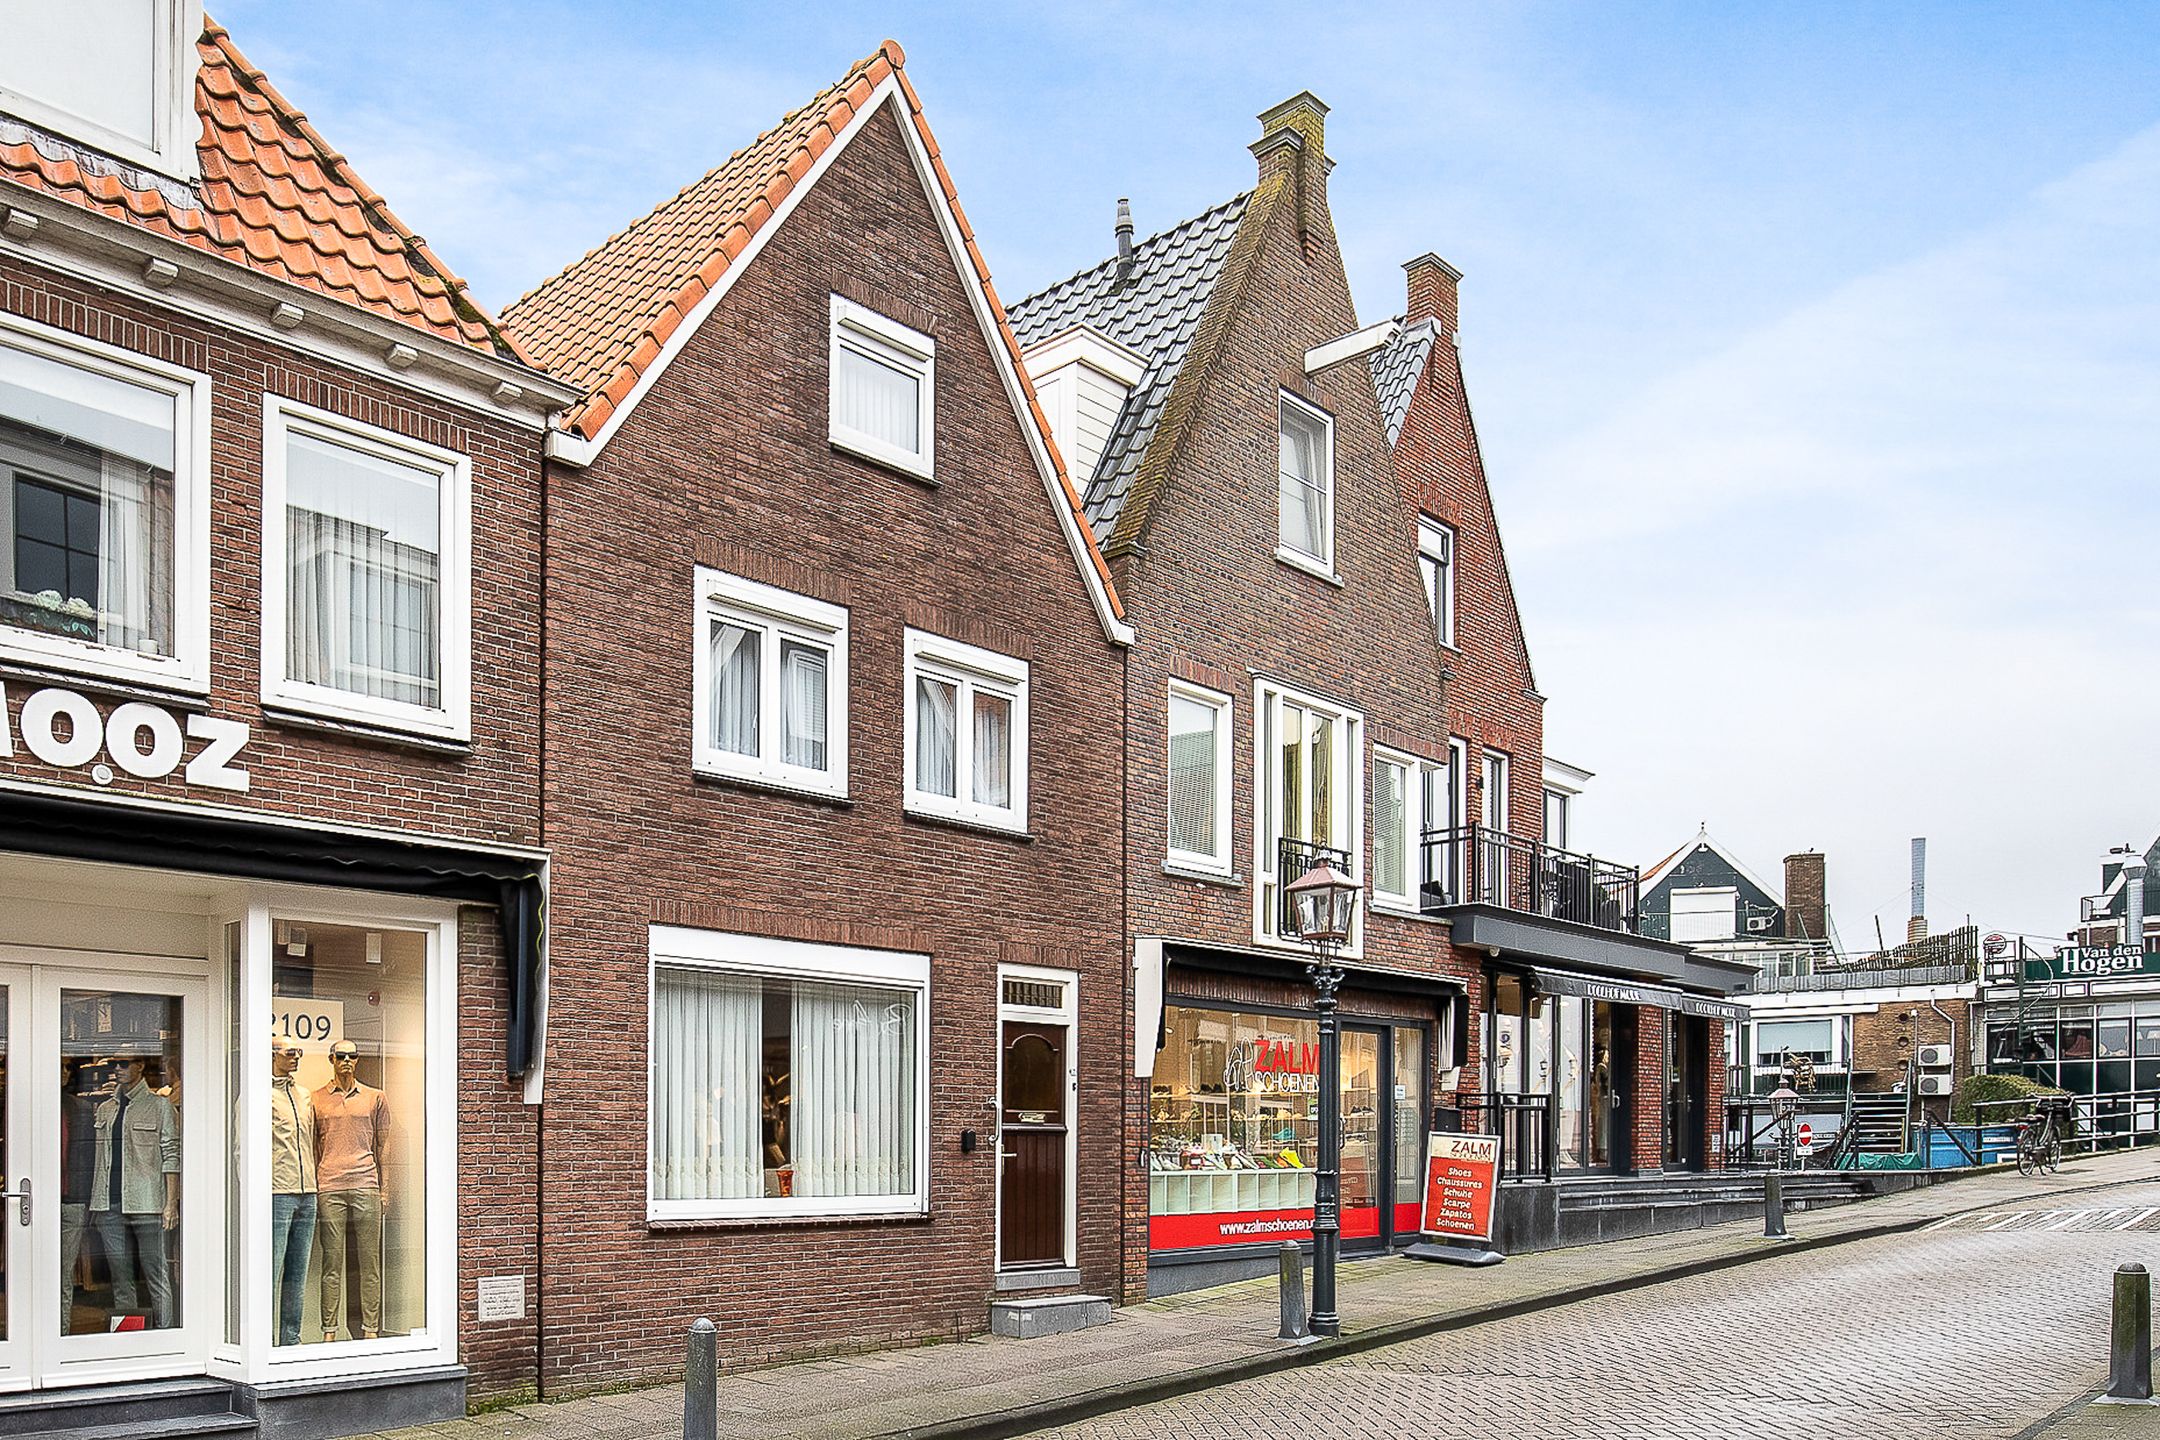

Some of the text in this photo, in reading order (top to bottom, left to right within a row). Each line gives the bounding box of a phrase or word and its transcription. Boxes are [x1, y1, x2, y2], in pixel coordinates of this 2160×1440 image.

[0, 681, 250, 792] OOZ
[2081, 945, 2142, 958] Van den
[2061, 948, 2143, 975] Hogen
[1254, 1040, 1319, 1074] ZALM
[1254, 1071, 1319, 1092] SCHOENEN
[1451, 1140, 1492, 1156] ZALM
[1448, 1167, 1472, 1177] Shoes
[1437, 1176, 1483, 1189] Chaussures
[1443, 1187, 1473, 1198] Schuhe
[1443, 1198, 1471, 1209] Scarpe
[1440, 1208, 1472, 1220] Zapatos
[1436, 1218, 1475, 1231] Schoenen
